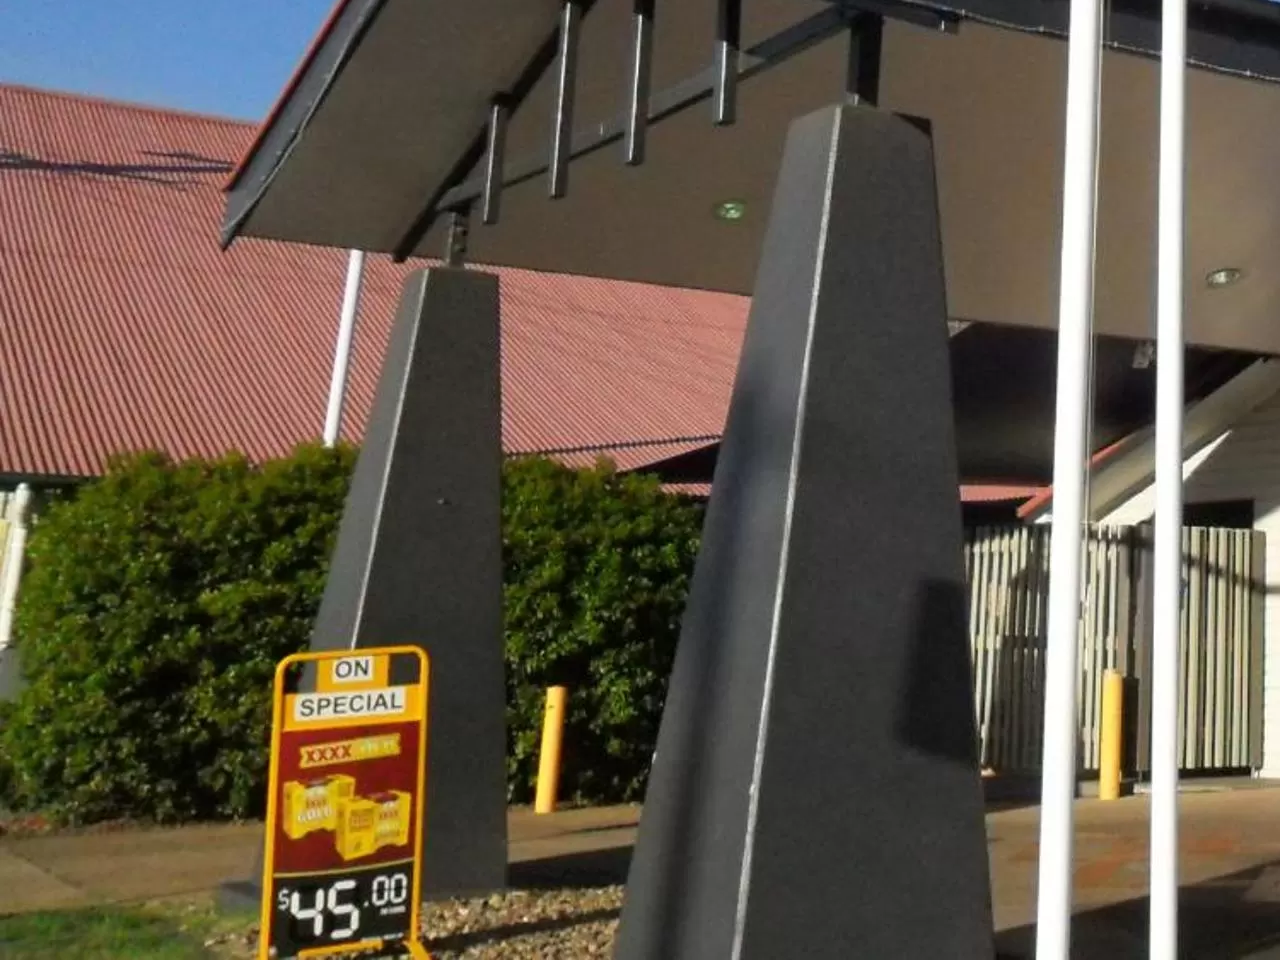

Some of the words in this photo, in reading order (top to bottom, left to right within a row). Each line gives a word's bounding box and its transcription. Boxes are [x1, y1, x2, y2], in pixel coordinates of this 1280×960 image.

[335, 659, 369, 679] ON
[300, 691, 403, 718] SPECIAL
[306, 744, 352, 761] XXXX
